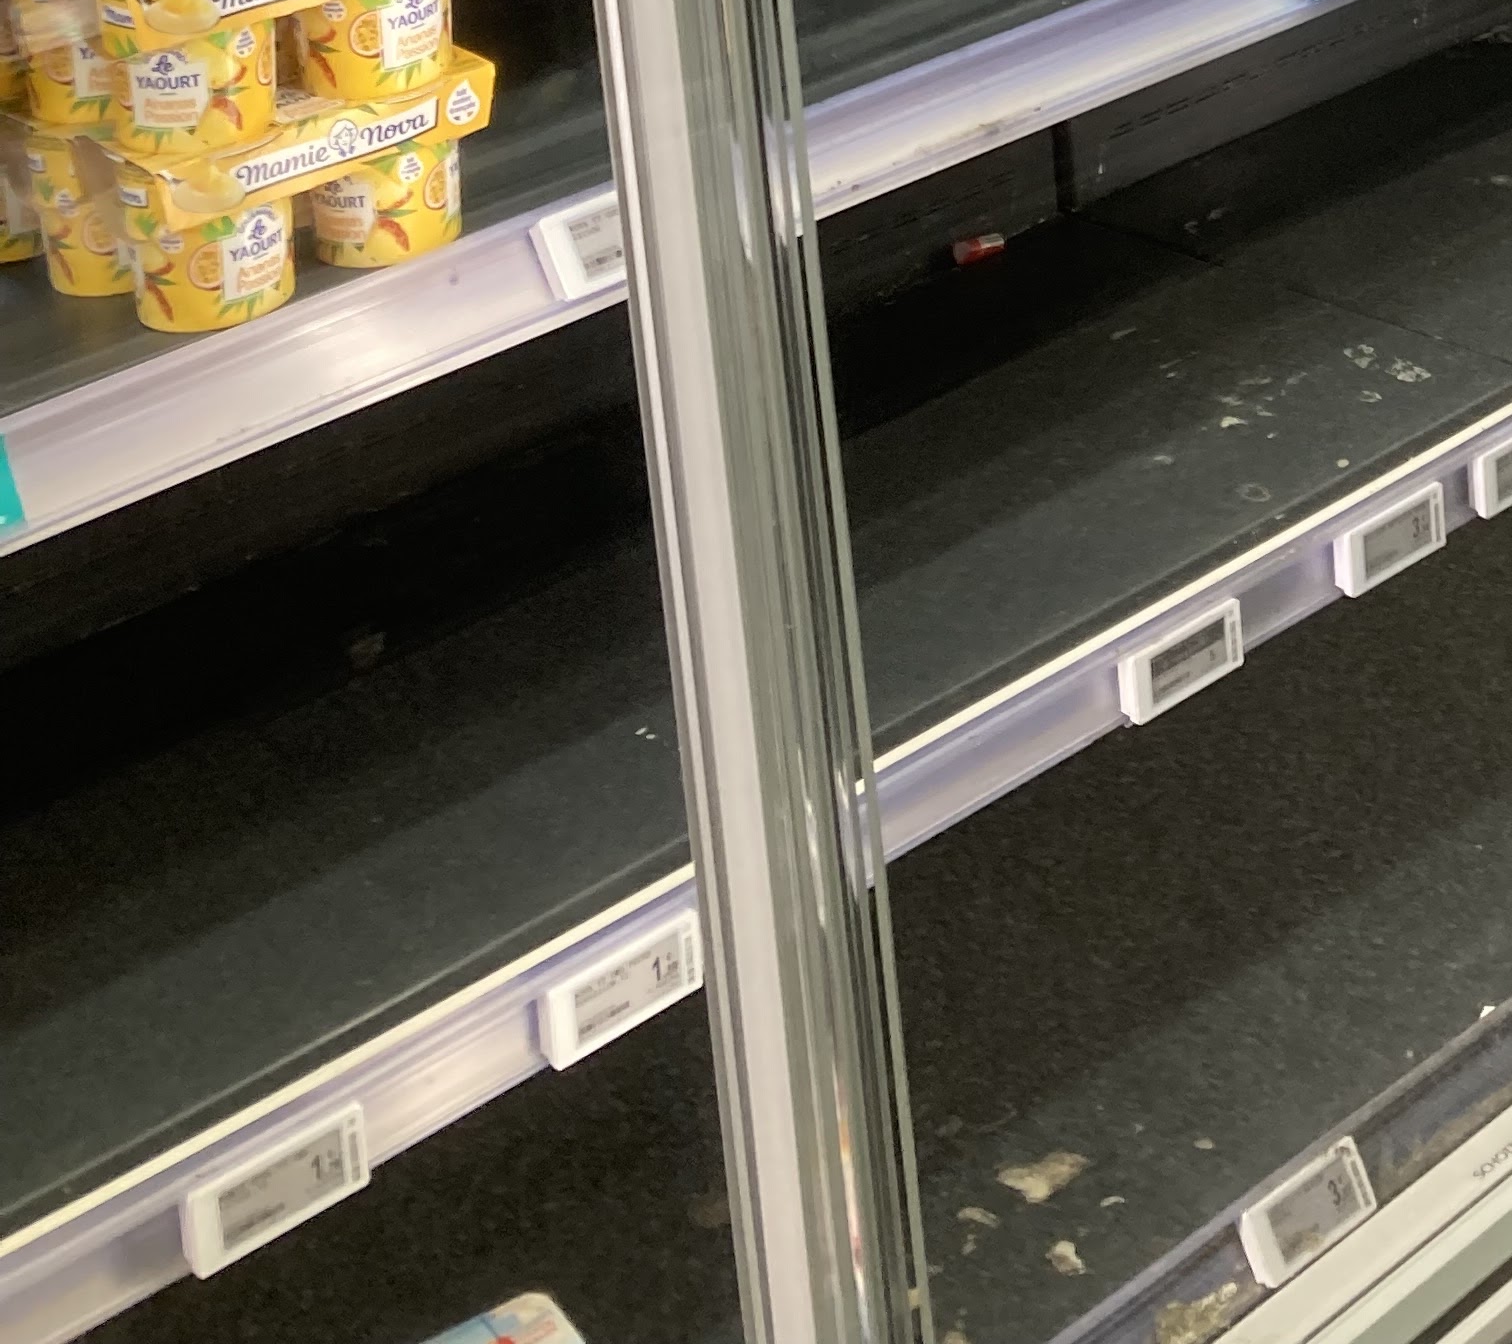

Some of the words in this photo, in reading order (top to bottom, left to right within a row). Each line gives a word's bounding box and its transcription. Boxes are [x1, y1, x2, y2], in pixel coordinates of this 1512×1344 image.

[387, 0, 439, 30] YAOURT
[134, 72, 201, 90] YAOURT
[235, 143, 330, 187] Mamie
[360, 112, 429, 145] Nova
[229, 228, 283, 262] YAOURT
